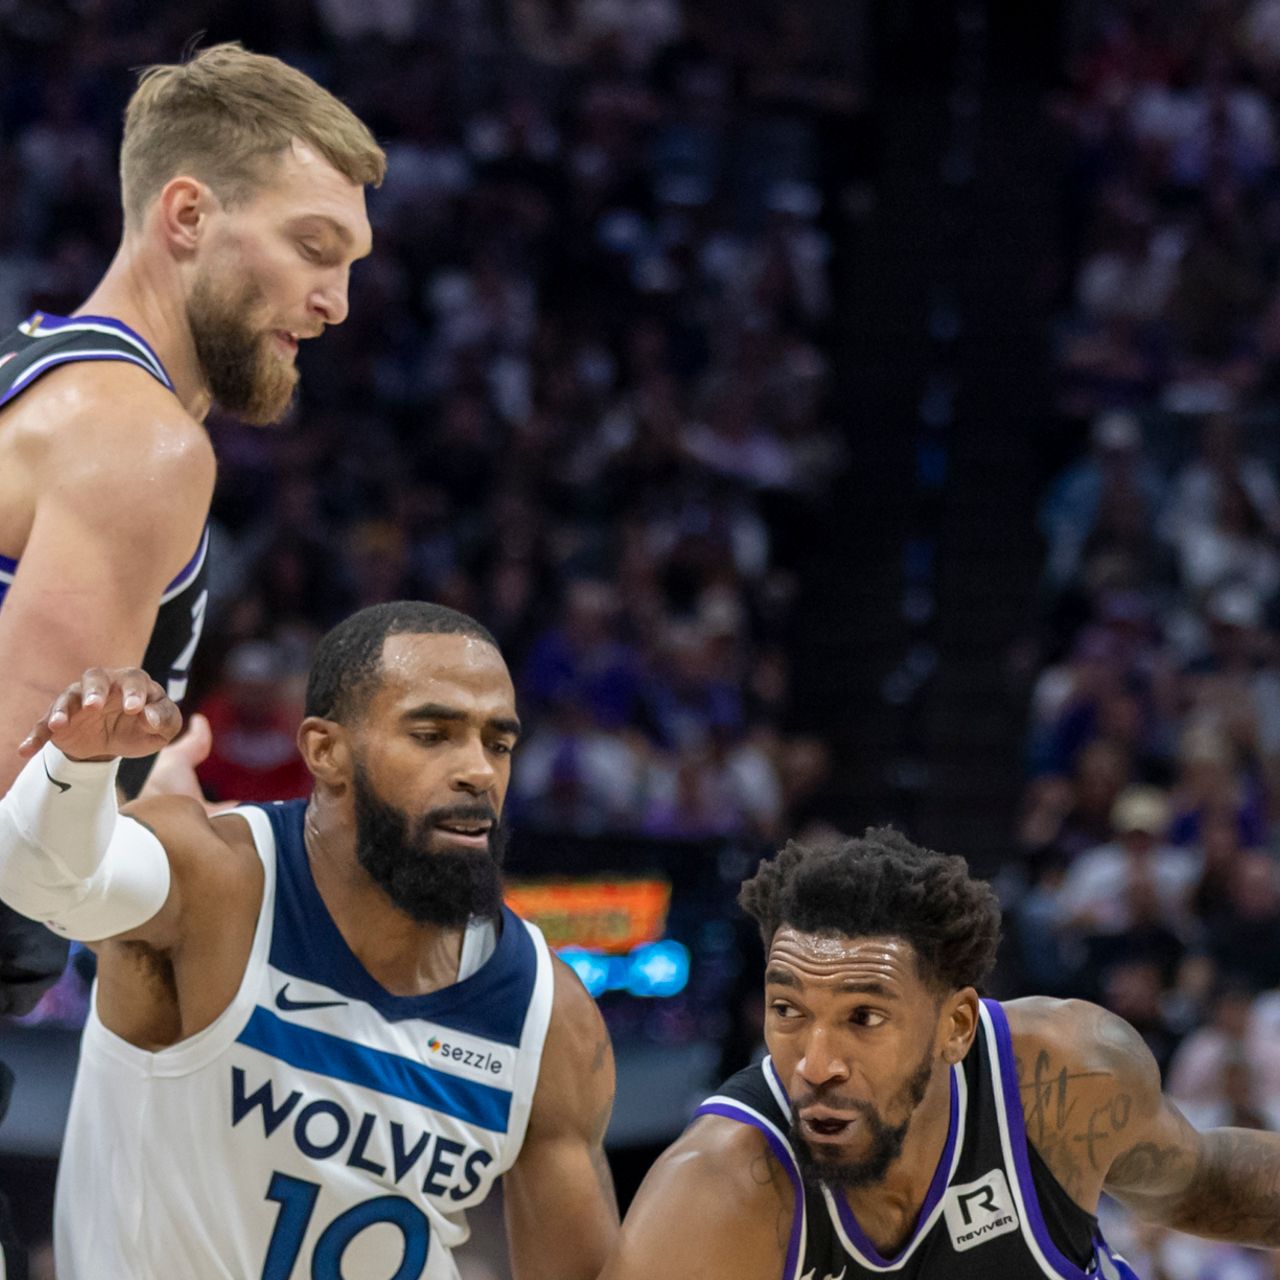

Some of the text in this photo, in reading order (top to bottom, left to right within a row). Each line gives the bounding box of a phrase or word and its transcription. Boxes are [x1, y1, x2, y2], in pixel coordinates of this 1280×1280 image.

[440, 1041, 503, 1075] sezzle
[231, 1065, 493, 1201] WOLVES
[956, 1215, 1013, 1244] REVIVER
